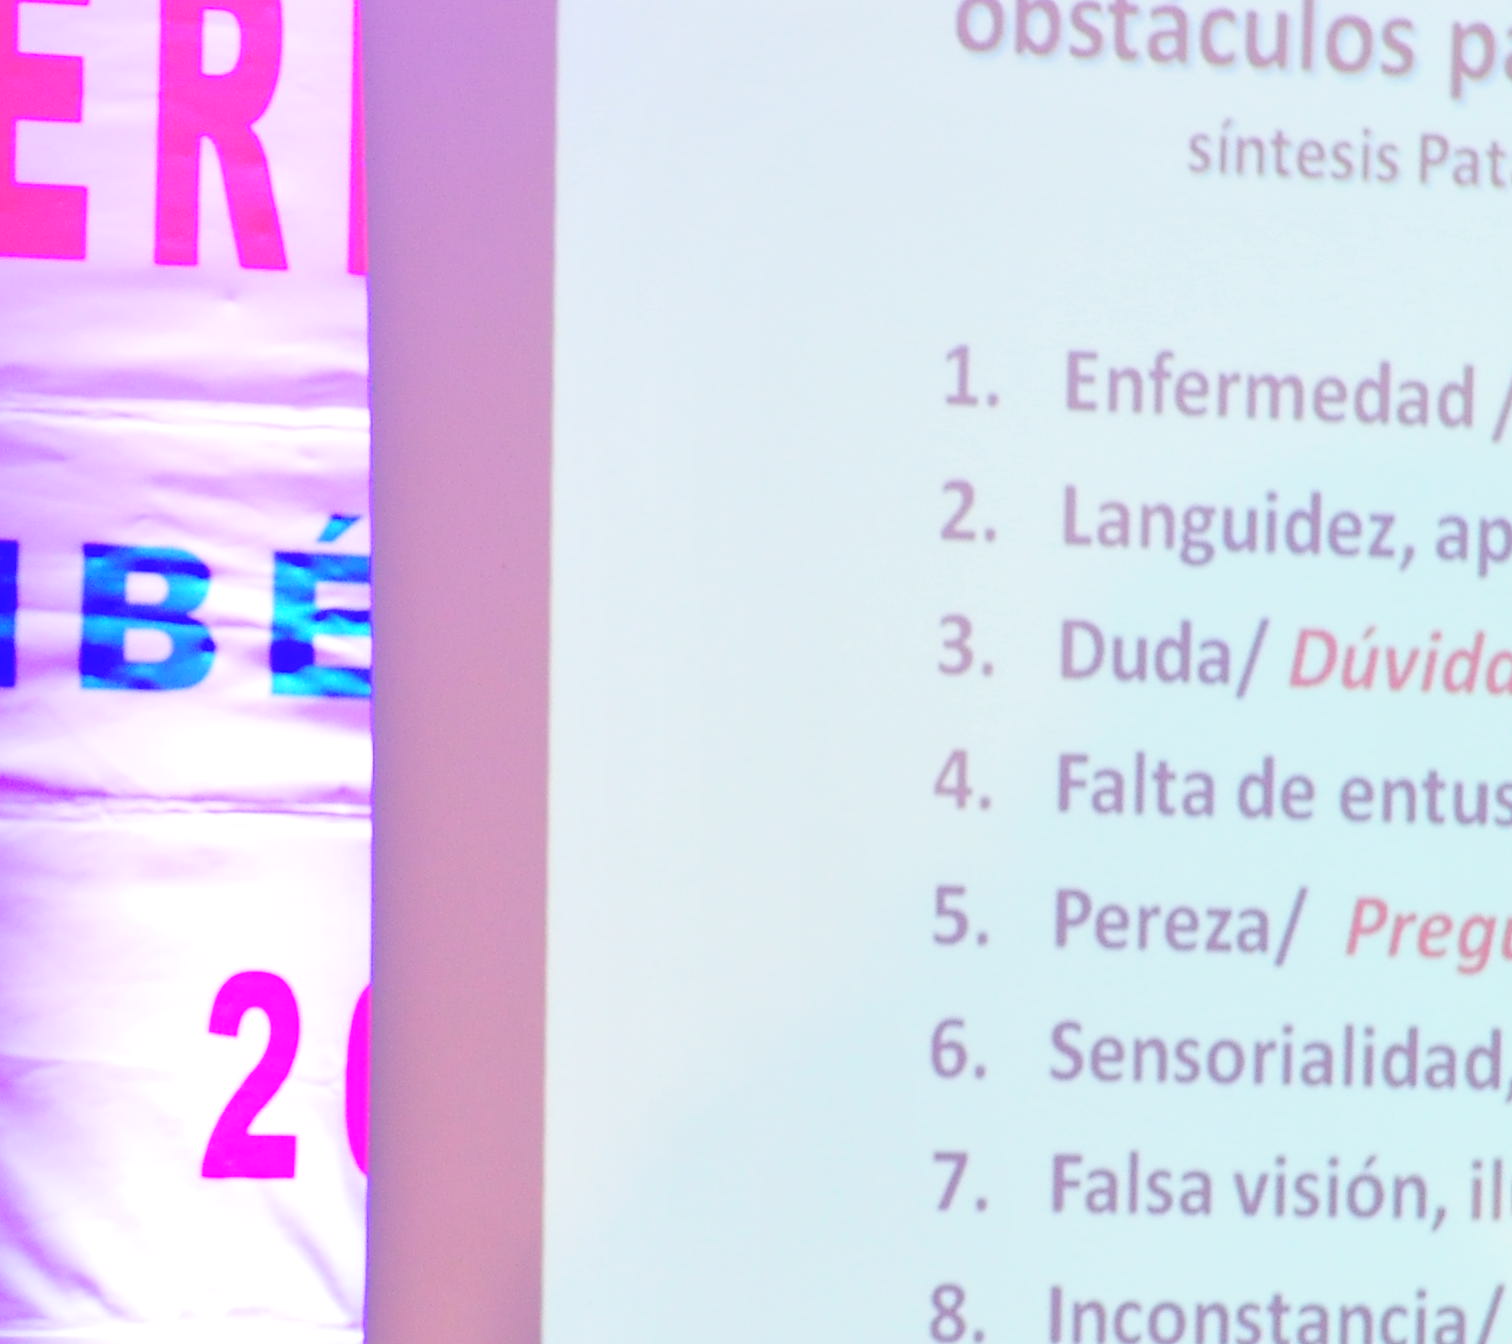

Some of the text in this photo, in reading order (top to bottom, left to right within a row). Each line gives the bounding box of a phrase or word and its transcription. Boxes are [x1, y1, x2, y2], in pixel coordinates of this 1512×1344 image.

[1188, 118, 1400, 184] síntesis
[945, 344, 1000, 408] 1.
[1065, 348, 1476, 429] Enfermedad
[940, 478, 997, 543] 2.
[1062, 483, 1416, 572] Languidez,
[938, 612, 994, 677] 3.
[933, 748, 992, 811] 4.
[1056, 750, 1216, 819] Falta
[1236, 754, 1317, 822] de
[932, 883, 989, 947] 5.
[201, 971, 371, 1182] 2
[929, 1016, 987, 1081] 6.
[932, 1150, 989, 1213] 7.
[1050, 1149, 1214, 1217] Falsa
[1232, 1154, 1448, 1232] visión,
